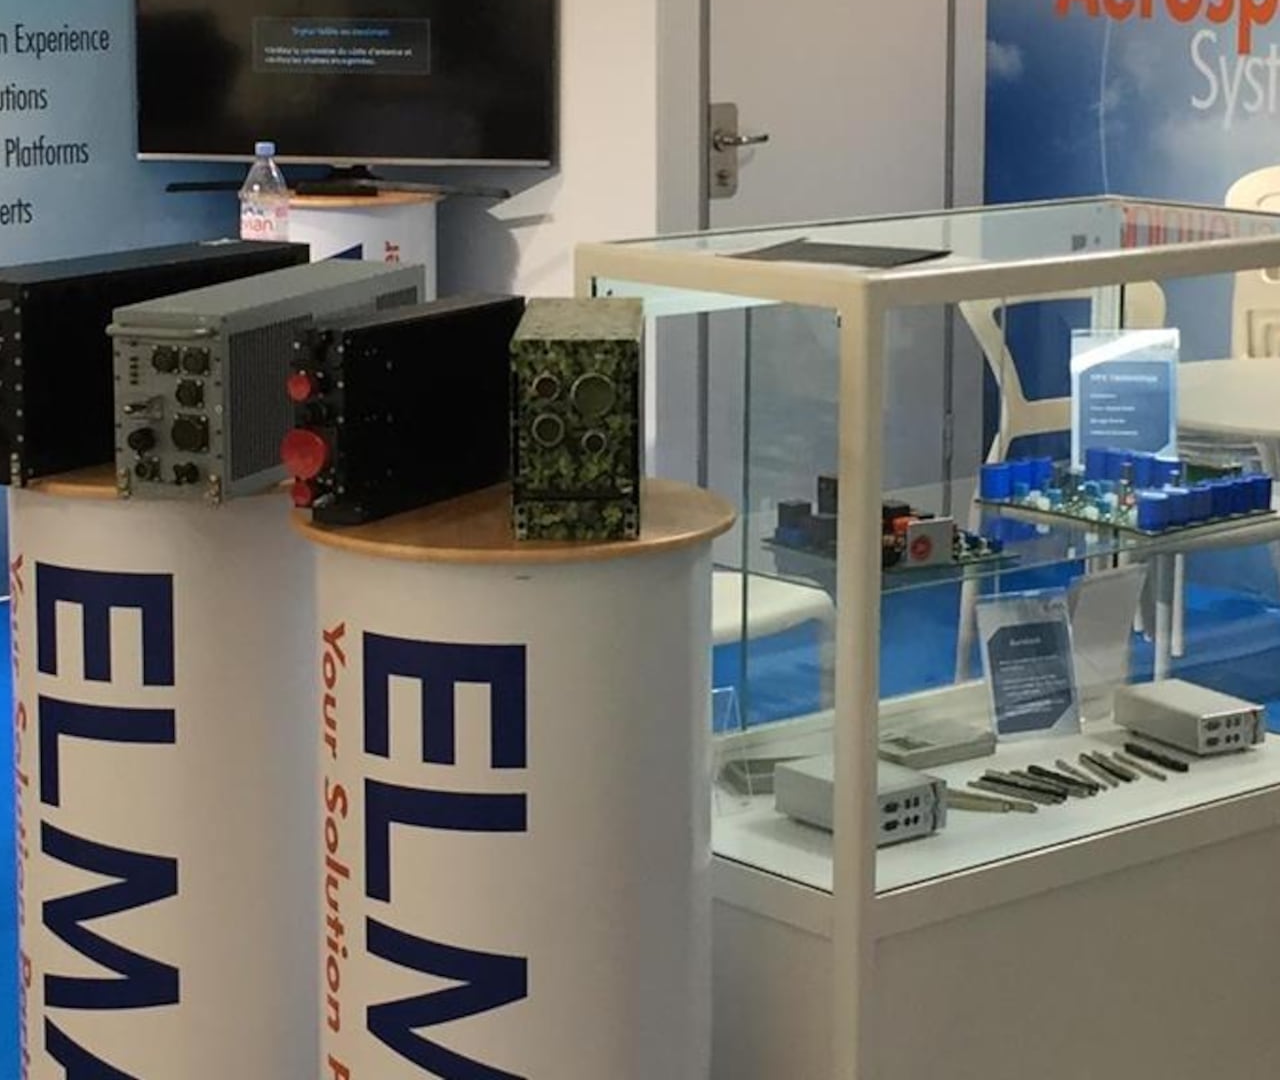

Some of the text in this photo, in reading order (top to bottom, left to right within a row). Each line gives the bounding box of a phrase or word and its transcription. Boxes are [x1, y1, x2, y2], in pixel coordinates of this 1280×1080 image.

[14, 23, 111, 59] Experience
[5, 136, 90, 169] Platforms
[322, 622, 347, 759] Your
[324, 777, 350, 1033] Solution
